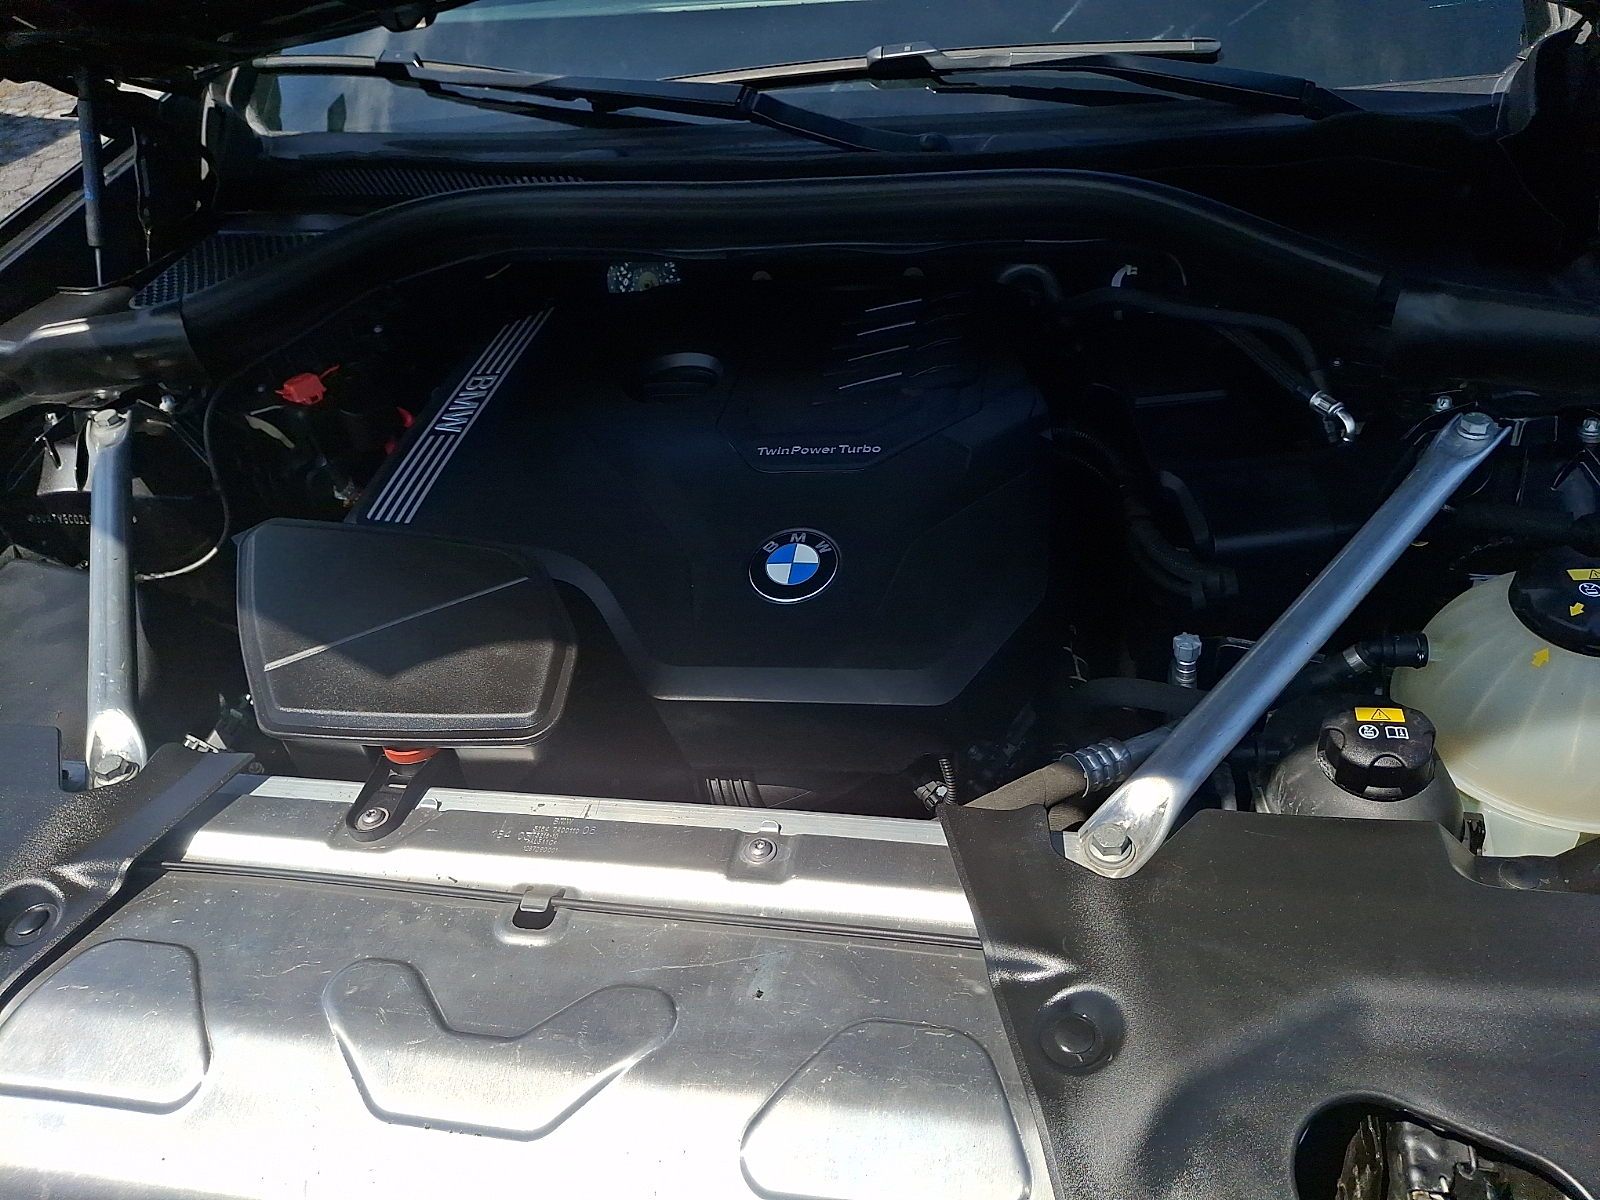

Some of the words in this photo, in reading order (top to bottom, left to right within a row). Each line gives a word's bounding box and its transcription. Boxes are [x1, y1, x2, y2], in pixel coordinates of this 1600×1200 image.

[434, 374, 499, 433] BMW
[838, 444, 882, 455] Turbo
[762, 533, 833, 554] BMW
